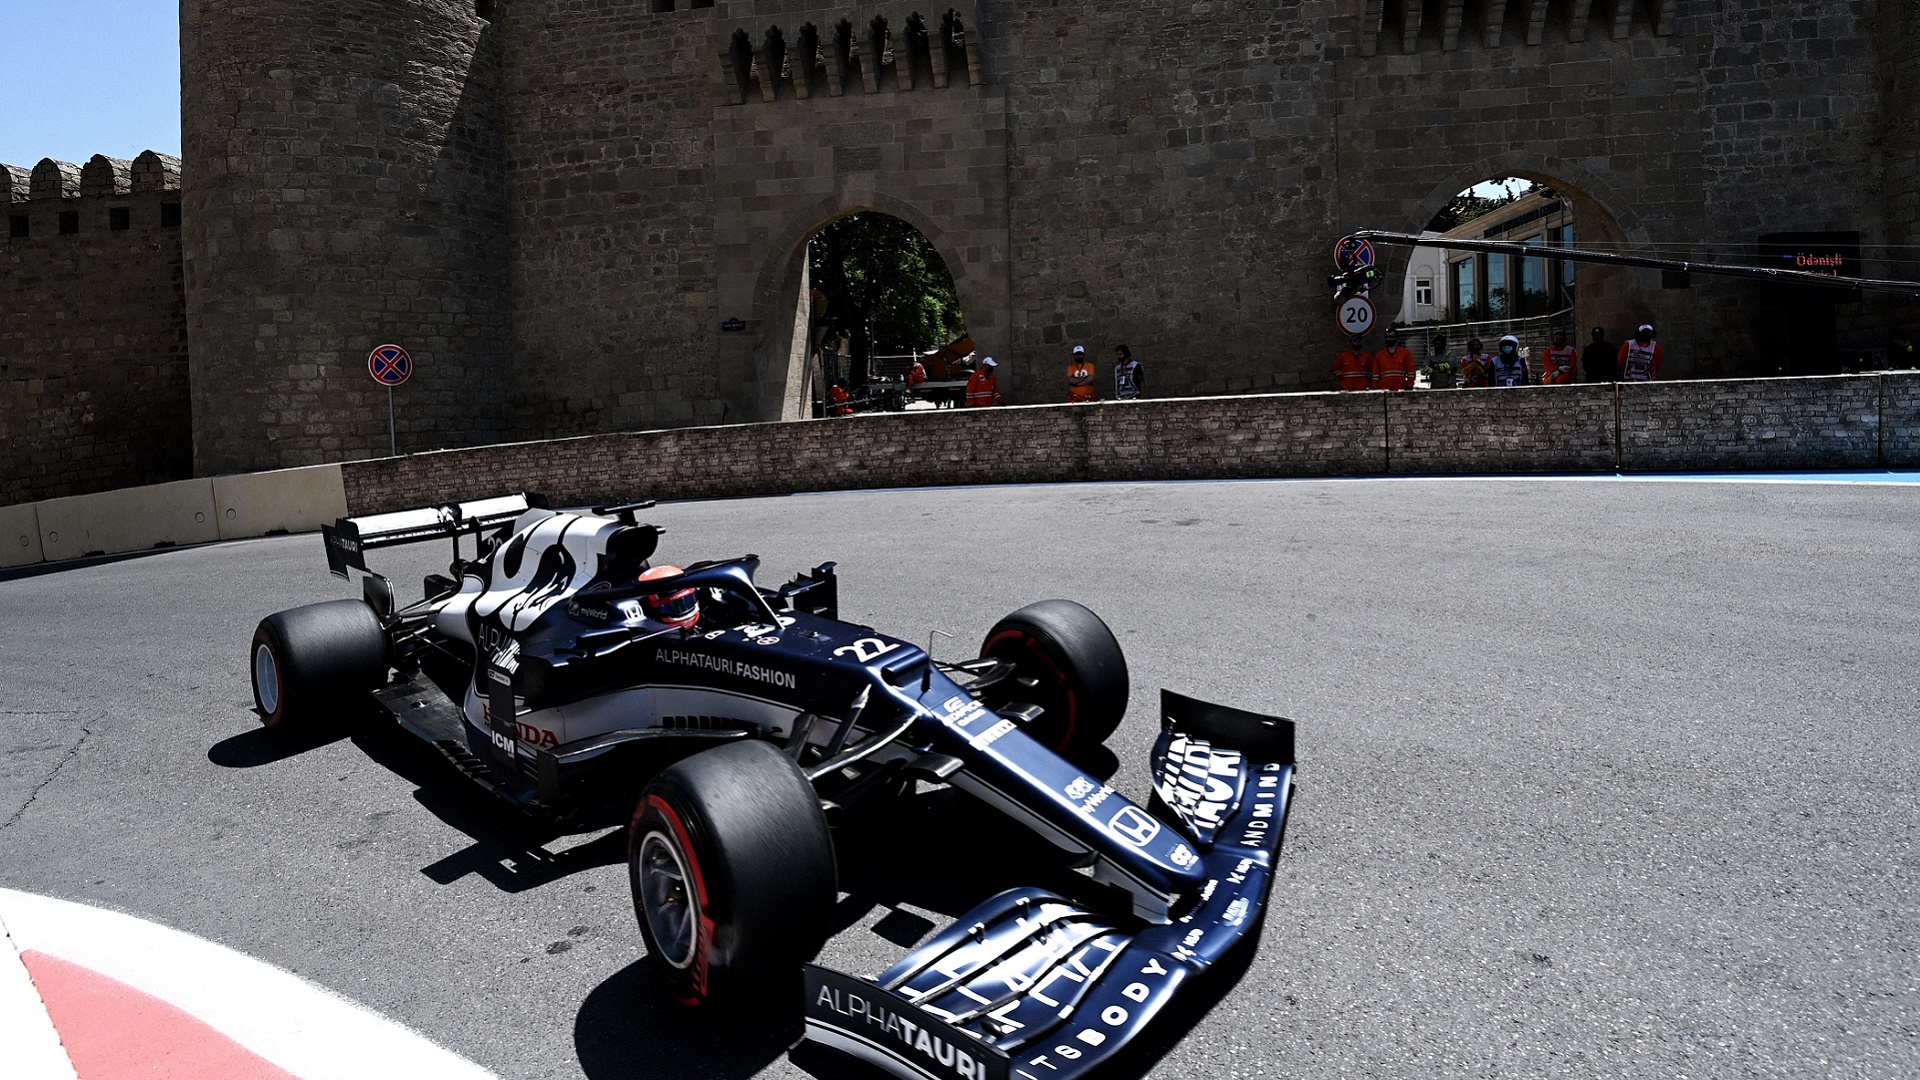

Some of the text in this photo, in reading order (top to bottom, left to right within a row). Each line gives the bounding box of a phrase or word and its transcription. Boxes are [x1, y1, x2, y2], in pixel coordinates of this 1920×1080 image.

[1346, 307, 1368, 323] 20
[833, 638, 900, 663] 22
[655, 648, 796, 689] ALPHATAURI.FASHION
[482, 702, 559, 748] HNDA
[491, 729, 515, 754] ICM
[816, 984, 986, 1080] ALPHATAURI
